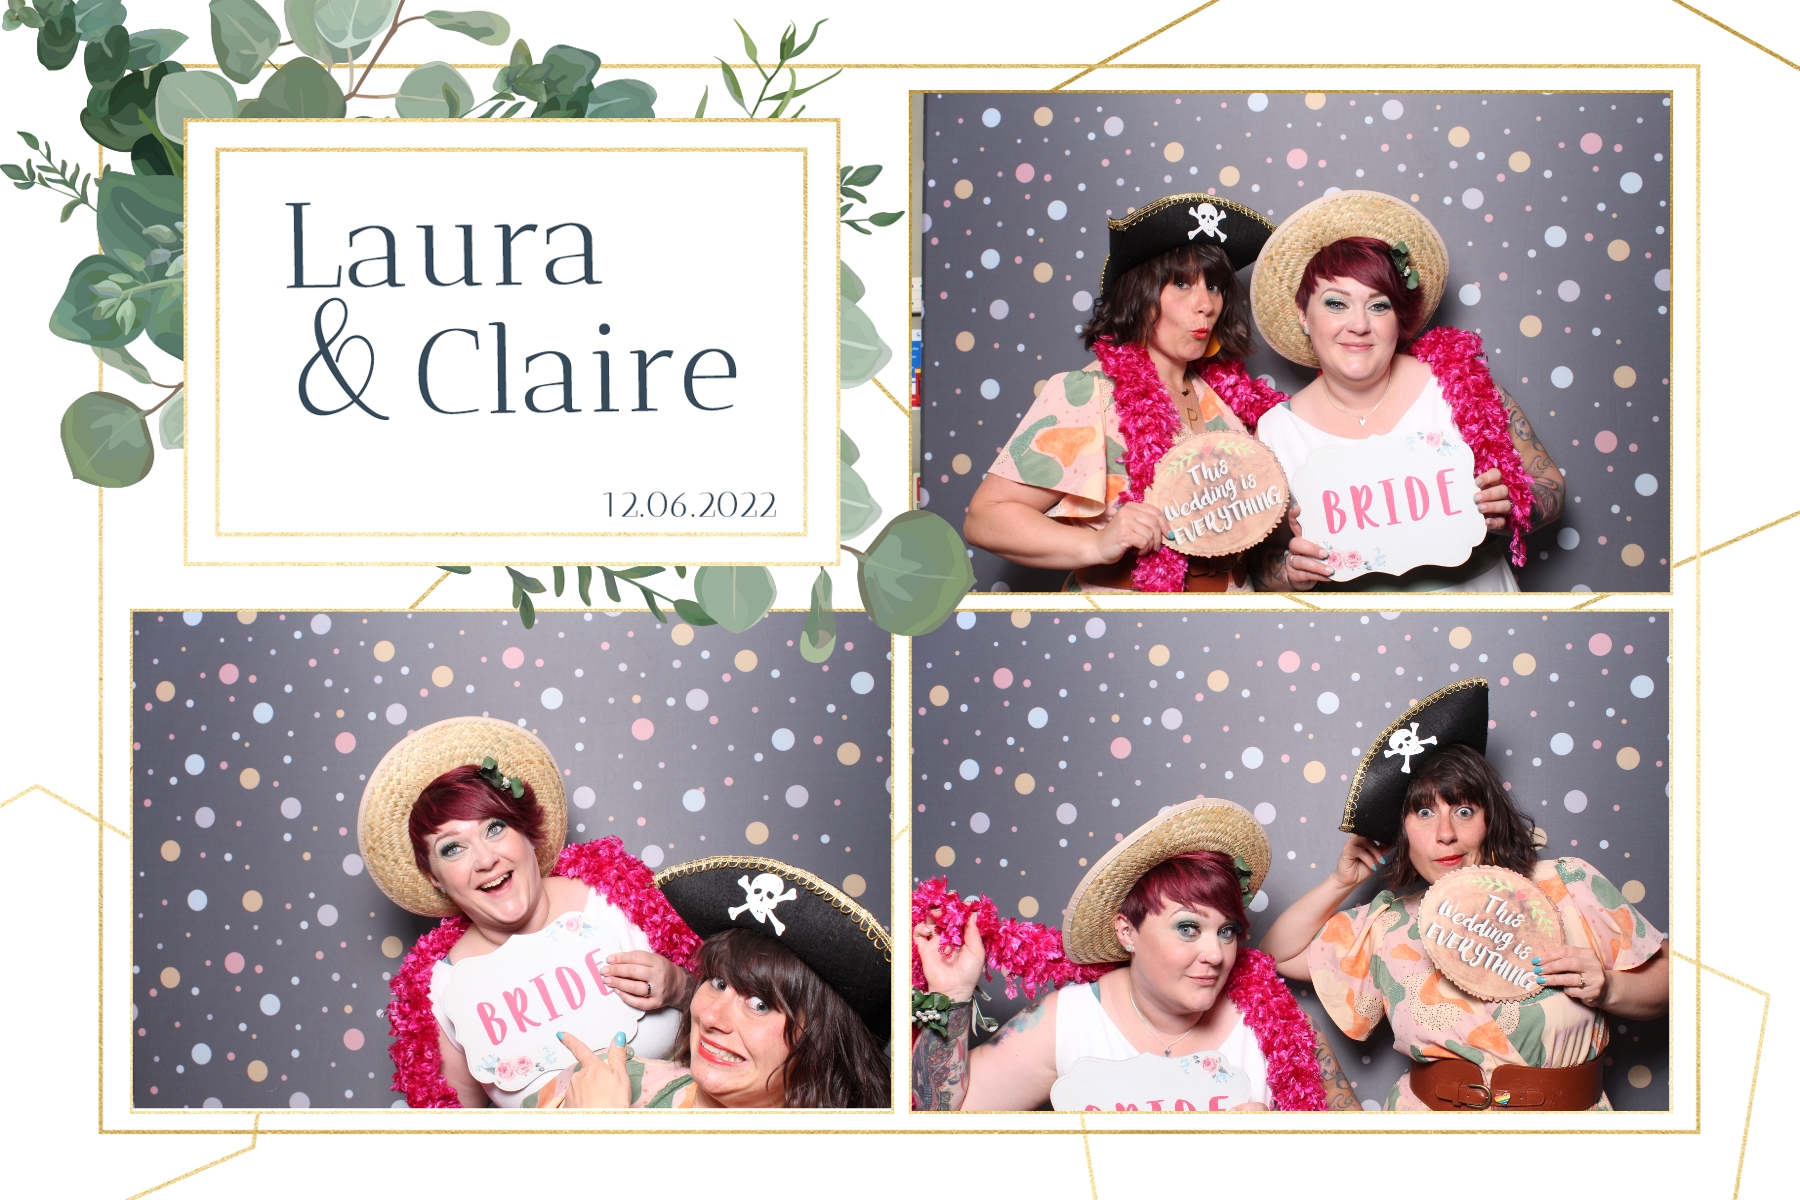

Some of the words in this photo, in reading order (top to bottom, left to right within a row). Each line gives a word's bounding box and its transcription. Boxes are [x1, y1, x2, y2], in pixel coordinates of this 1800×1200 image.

[1164, 478, 1238, 522] Wedding
[1240, 473, 1257, 490] is
[1186, 459, 1229, 486] This
[1323, 469, 1461, 534] BRIDE
[1173, 485, 1282, 546] EVERYTHING
[1438, 899, 1515, 951] Wedding
[1513, 939, 1533, 960] is
[1485, 893, 1526, 928] This
[1425, 921, 1540, 992] EVERYTHING
[476, 947, 616, 1046] BRIDE
